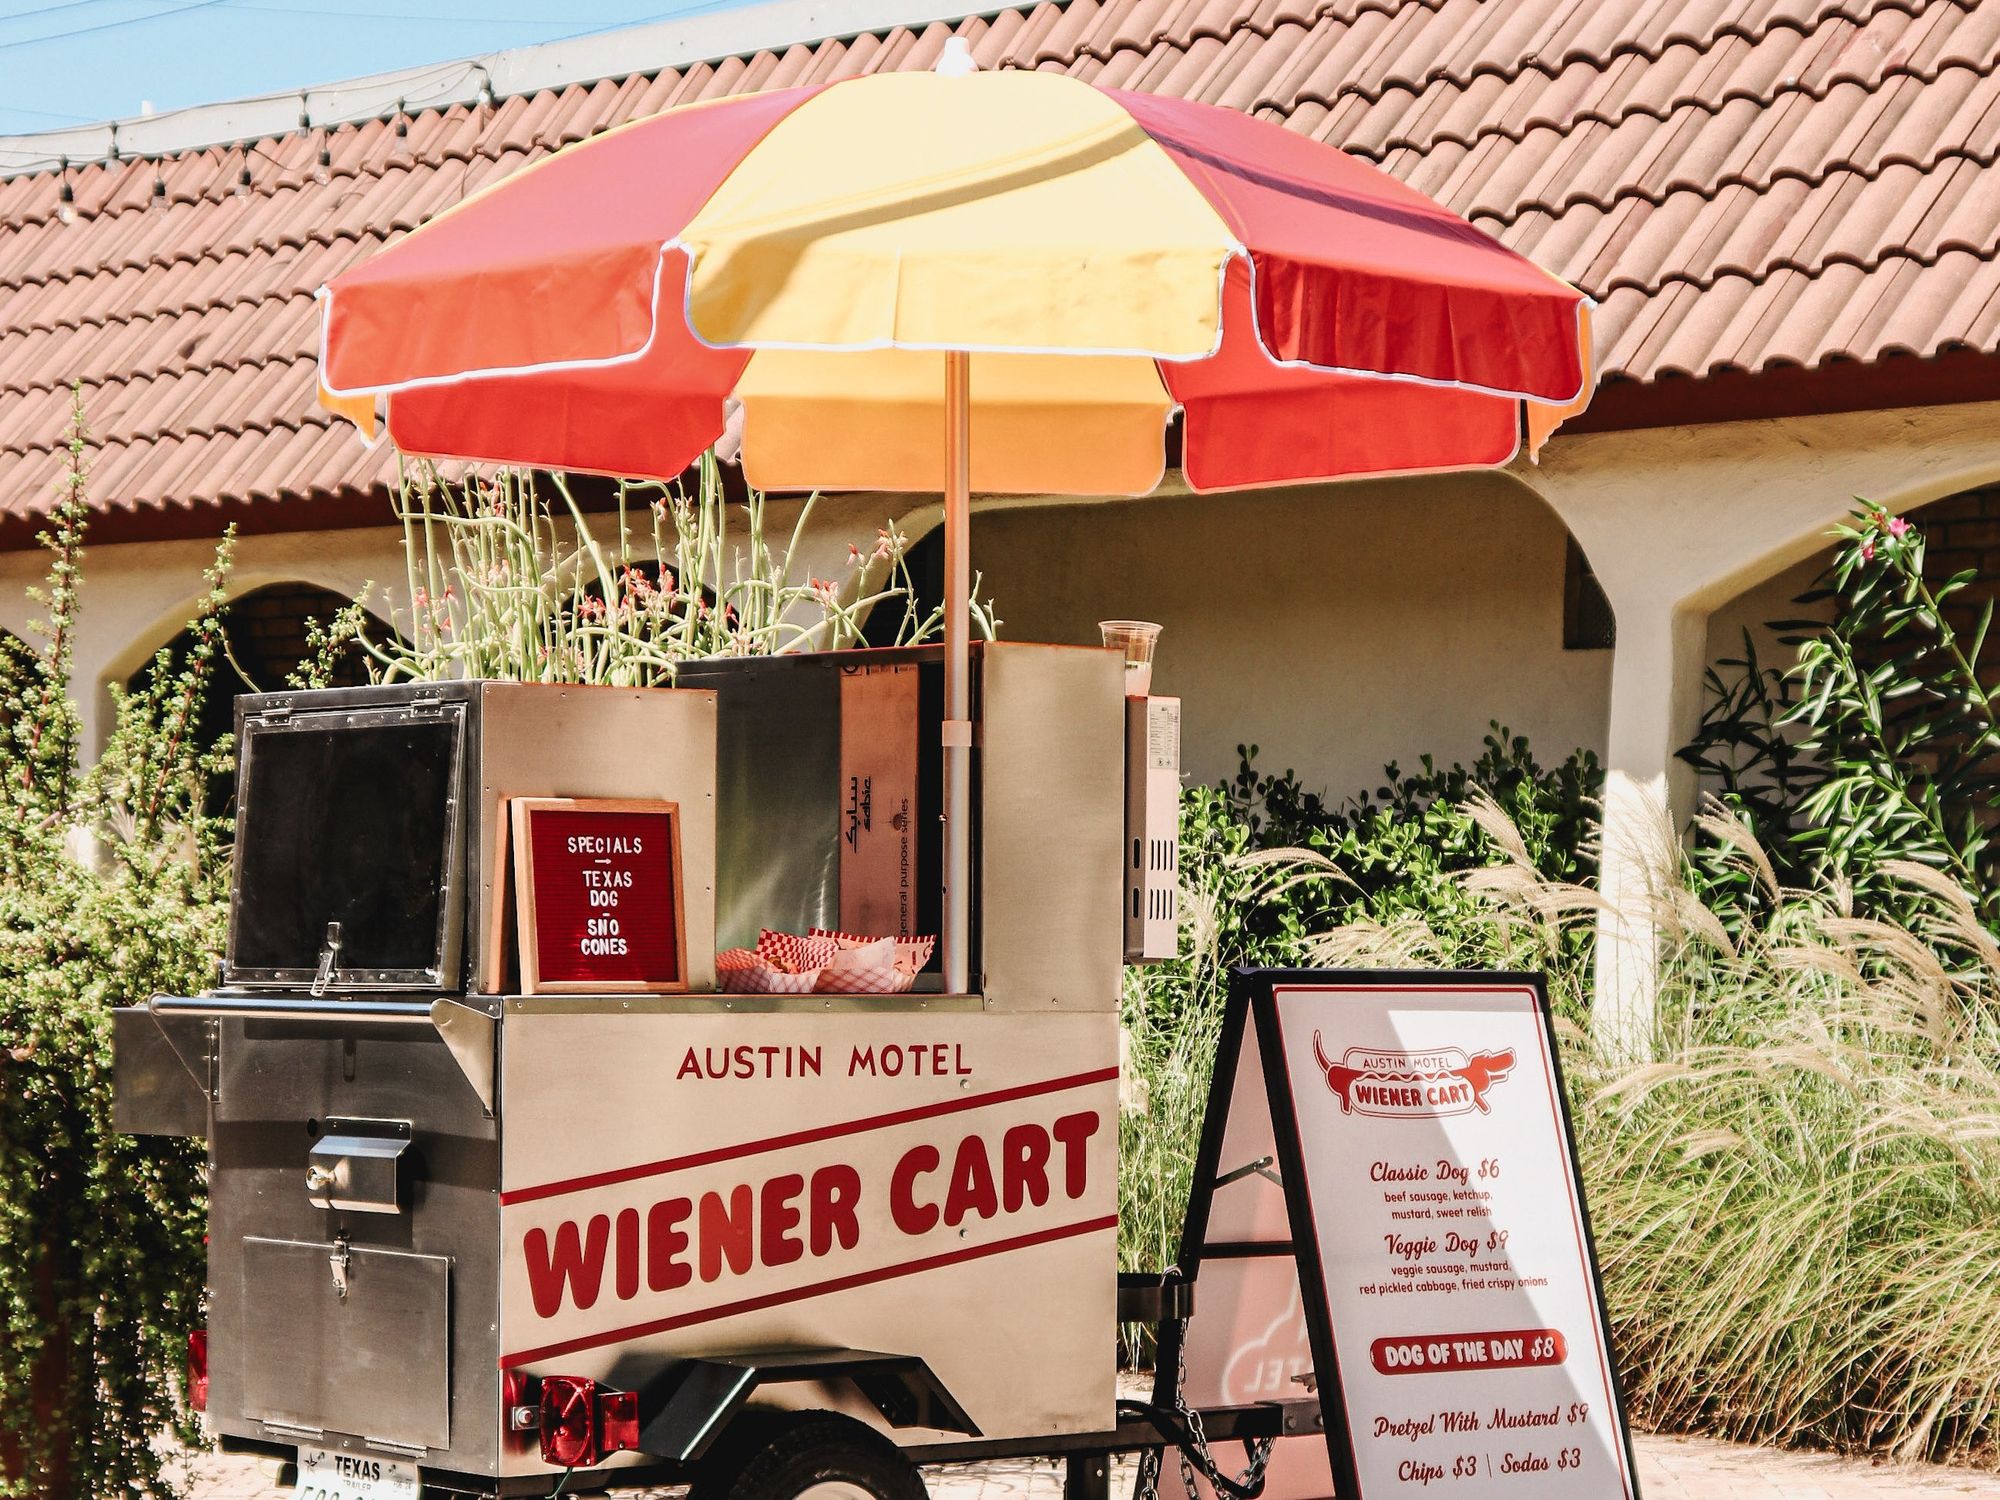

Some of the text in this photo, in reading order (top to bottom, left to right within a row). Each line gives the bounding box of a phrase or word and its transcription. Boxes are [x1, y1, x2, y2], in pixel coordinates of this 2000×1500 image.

[567, 836, 643, 854] SPECIALS
[899, 797, 909, 938] general purpose series
[582, 870, 633, 888] TEXAS
[589, 890, 618, 907] DOG
[587, 918, 620, 936] SNO
[580, 938, 627, 956] CONES
[676, 1043, 973, 1080] AUSTIN MOTEL
[1363, 1057, 1452, 1069] AUSTIN MOTEL
[1355, 1083, 1469, 1107] WIENER CART
[1370, 1158, 1500, 1185] Classic Dog $6
[1384, 1191, 1406, 1203] beef
[1409, 1192, 1451, 1204] sausage,
[523, 1110, 1100, 1319] WIENER CART
[1391, 1206, 1492, 1220] mustard, sweet relish
[1384, 1229, 1509, 1260] Veggie Dog $9
[1391, 1260, 1512, 1278] veggie sausage, mustard,
[1359, 1276, 1548, 1296] red pickled cabbage, fried crispy onions
[1385, 1336, 1555, 1367] DOG OF THE DAY $8
[1374, 1402, 1589, 1442] Pretzel With Mustard $9
[334, 1455, 380, 1482] TEXAS
[1398, 1448, 1581, 1486] Chips $3 Sodas $3
